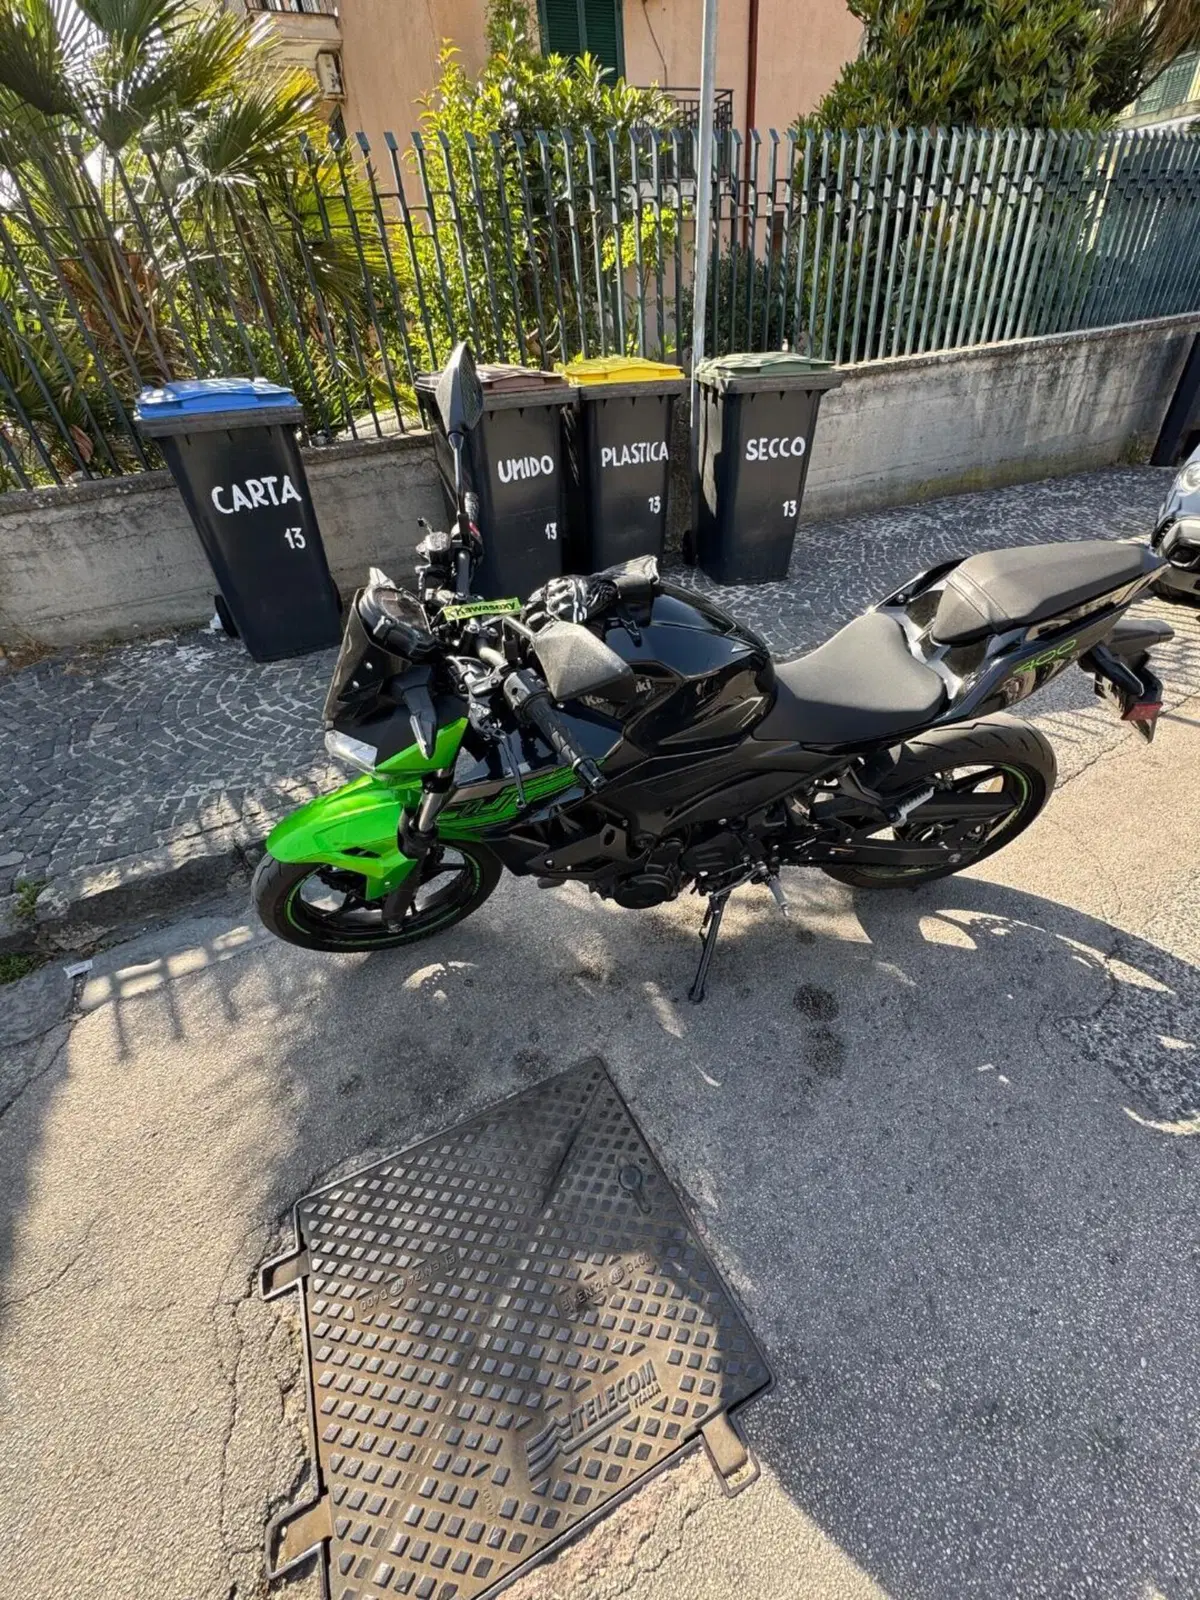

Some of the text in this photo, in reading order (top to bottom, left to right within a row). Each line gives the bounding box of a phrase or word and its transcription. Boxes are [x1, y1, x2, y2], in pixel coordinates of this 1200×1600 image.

[601, 441, 669, 468] PLASTICA
[745, 436, 806, 461] SECCO
[497, 455, 554, 483] UMIDO
[211, 475, 302, 514] CARTA
[648, 495, 662, 514] 13
[782, 500, 797, 517] 13
[284, 527, 306, 549] 13
[544, 522, 558, 540] 13
[1013, 639, 1077, 674] 400
[361, 1288, 388, 1311] D400
[571, 1359, 657, 1432] TELECOM
[634, 1382, 661, 1408] ITALIA
